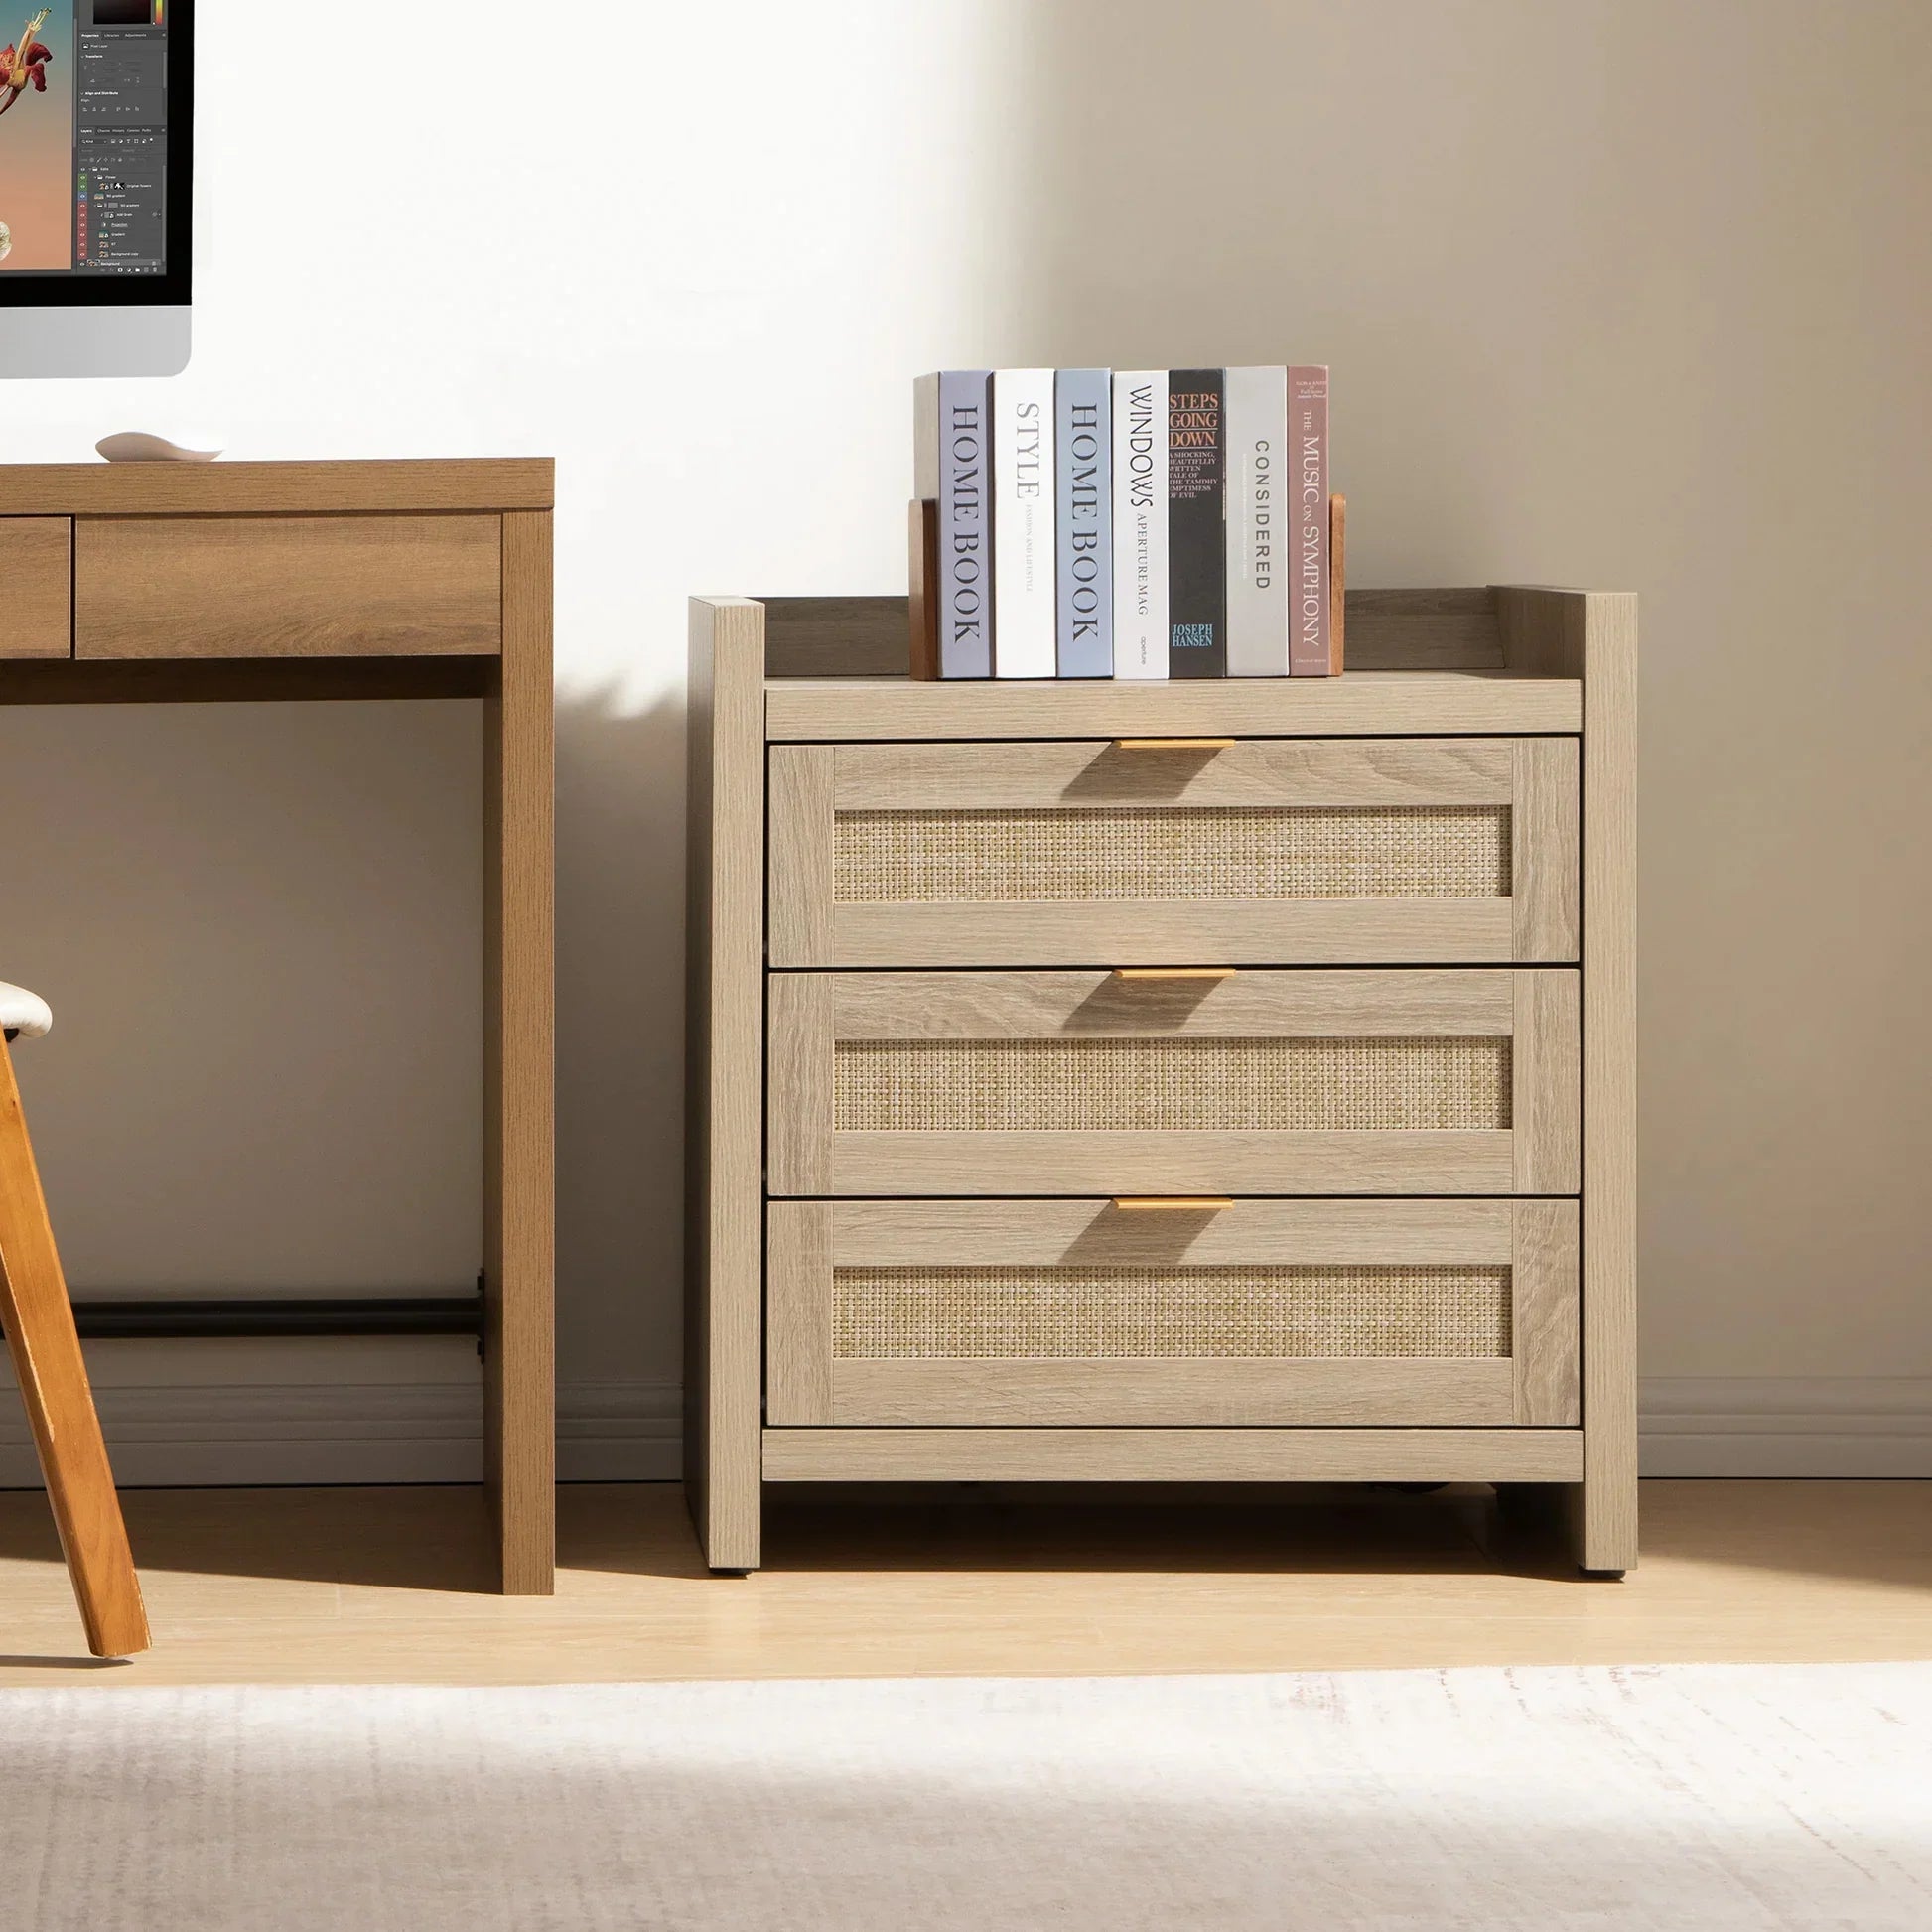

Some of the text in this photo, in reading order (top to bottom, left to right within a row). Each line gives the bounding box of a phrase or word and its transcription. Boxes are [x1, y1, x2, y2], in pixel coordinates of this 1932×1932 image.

[1170, 393, 1218, 409] STEPS
[1170, 412, 1218, 428] GOING
[1303, 409, 1312, 431] THE
[1017, 403, 1039, 499] STYLE
[1130, 385, 1153, 507] WINDOWS
[1170, 431, 1216, 447] DOWN
[1303, 436, 1319, 503] MUSIC
[953, 405, 980, 643] HOME BOOK
[1072, 403, 1098, 642] HOME BOOK
[1255, 440, 1270, 589] CONSIDERED
[1303, 505, 1312, 522] ON
[1137, 513, 1148, 616] APERTURE MAG
[1303, 526, 1319, 646] SYMPHONY
[1173, 623, 1212, 635] JOSEPH
[1173, 635, 1212, 646] HANSEN
